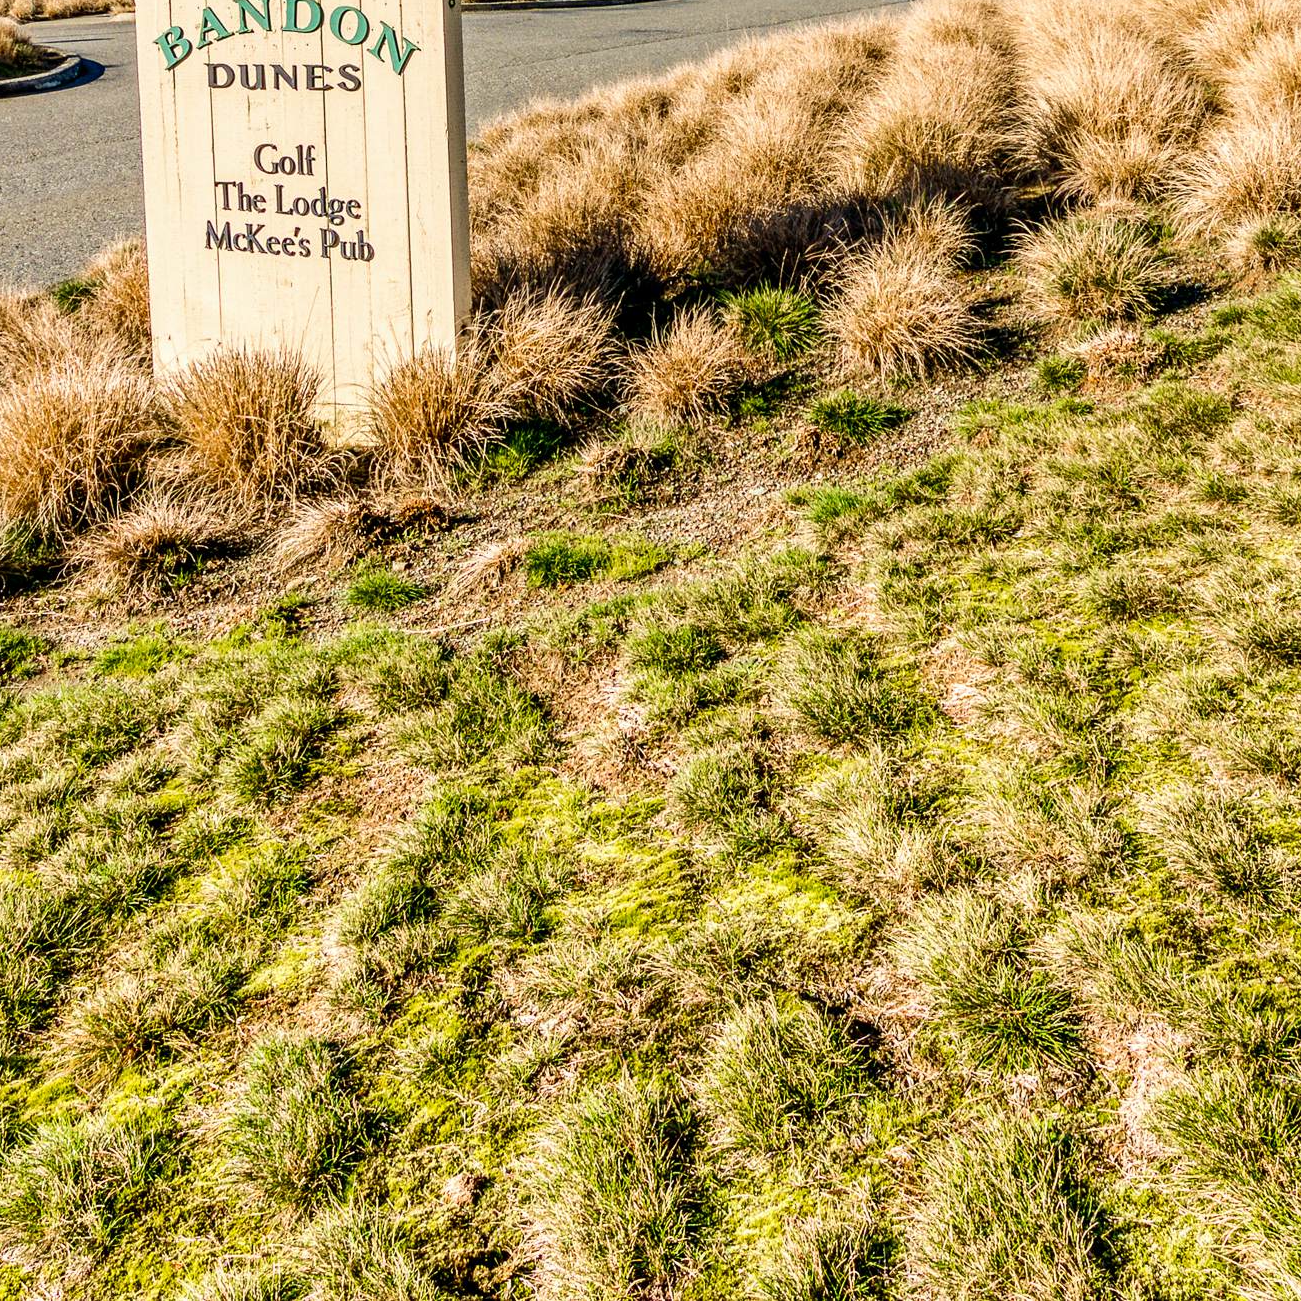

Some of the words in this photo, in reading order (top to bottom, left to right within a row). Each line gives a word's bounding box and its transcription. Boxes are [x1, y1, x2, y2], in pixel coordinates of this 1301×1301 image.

[204, 62, 362, 92] DUNES
[253, 143, 317, 177] Golf
[215, 181, 267, 214] The
[274, 184, 362, 226] Lodge
[205, 220, 312, 258] McKee's
[319, 228, 375, 262] Pub
